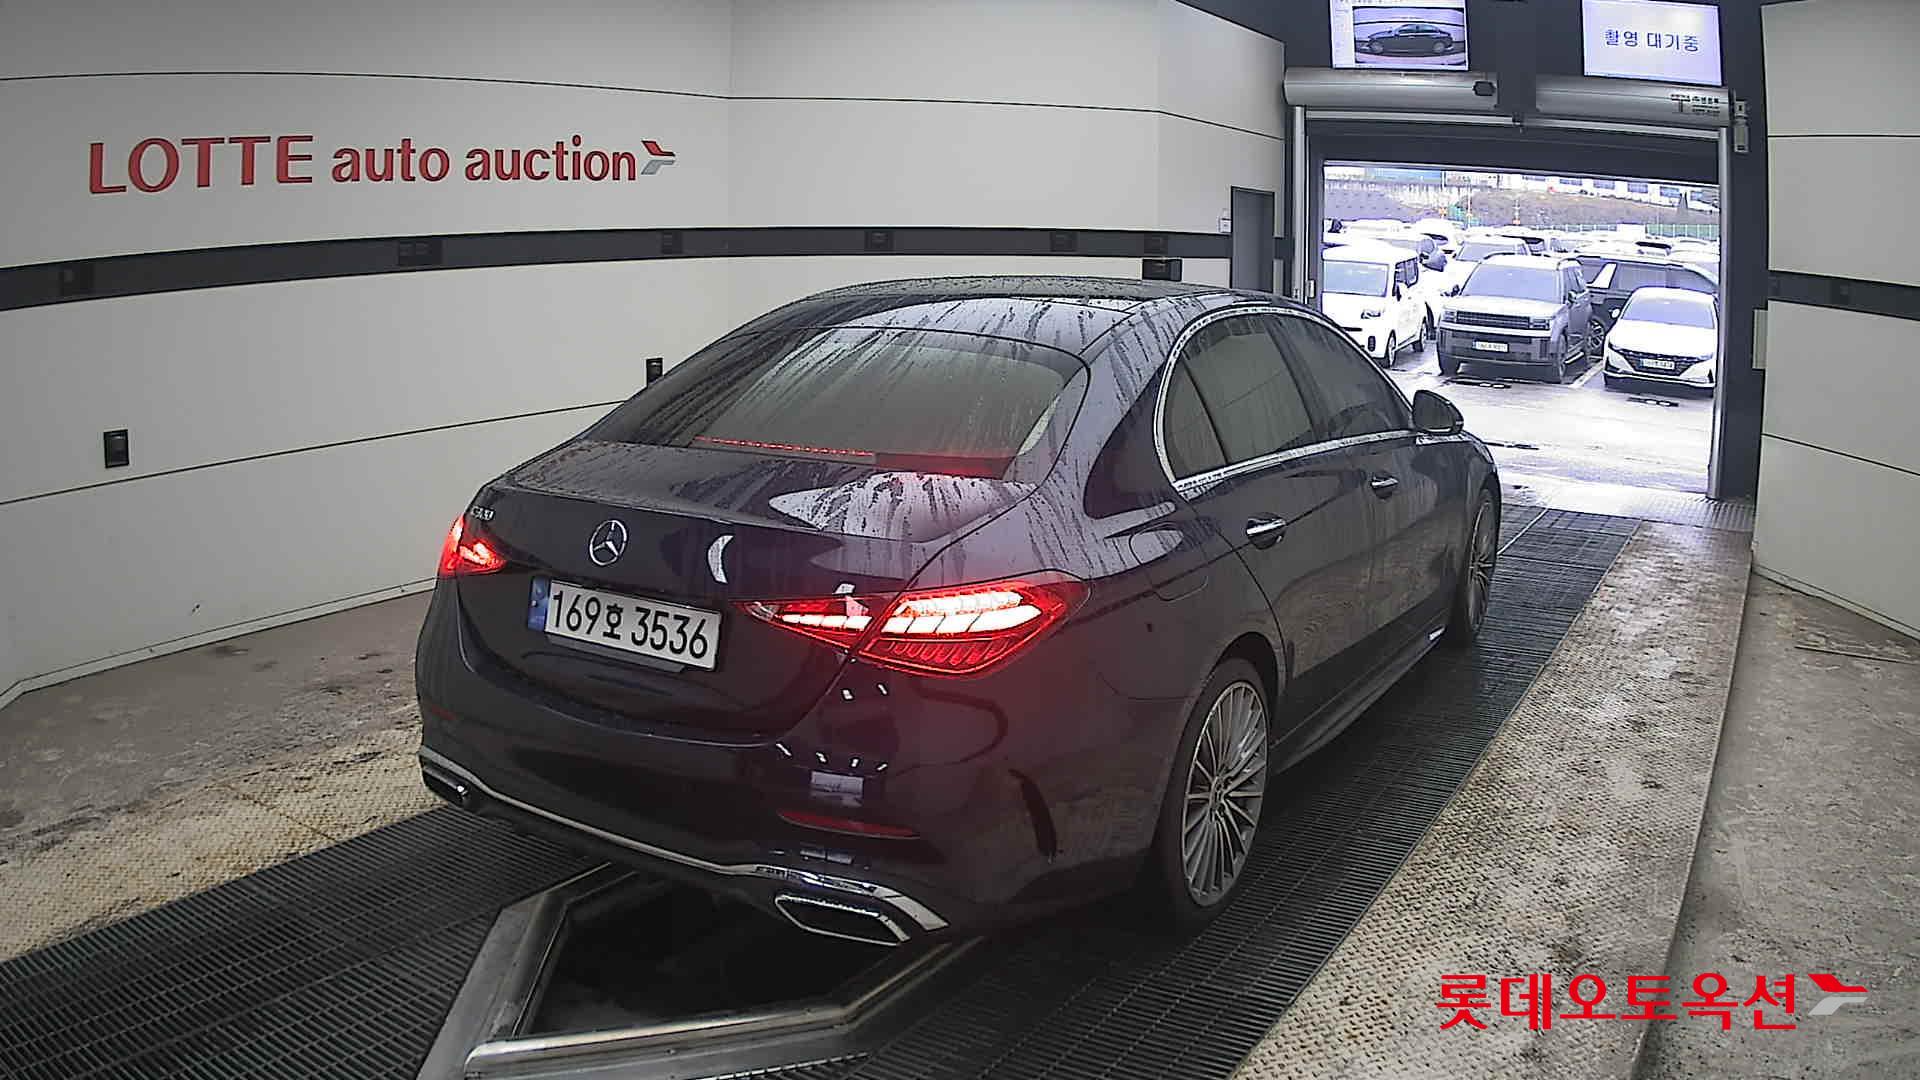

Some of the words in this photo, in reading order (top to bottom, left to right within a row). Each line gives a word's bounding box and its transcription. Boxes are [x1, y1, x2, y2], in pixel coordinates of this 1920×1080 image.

[1604, 29, 1638, 47] 촬영
[1647, 32, 1699, 52] 대기중
[89, 134, 314, 195] LOTTE
[331, 137, 450, 183] auto
[464, 134, 637, 183] auction
[553, 590, 624, 640] 169호
[631, 606, 708, 659] 3536
